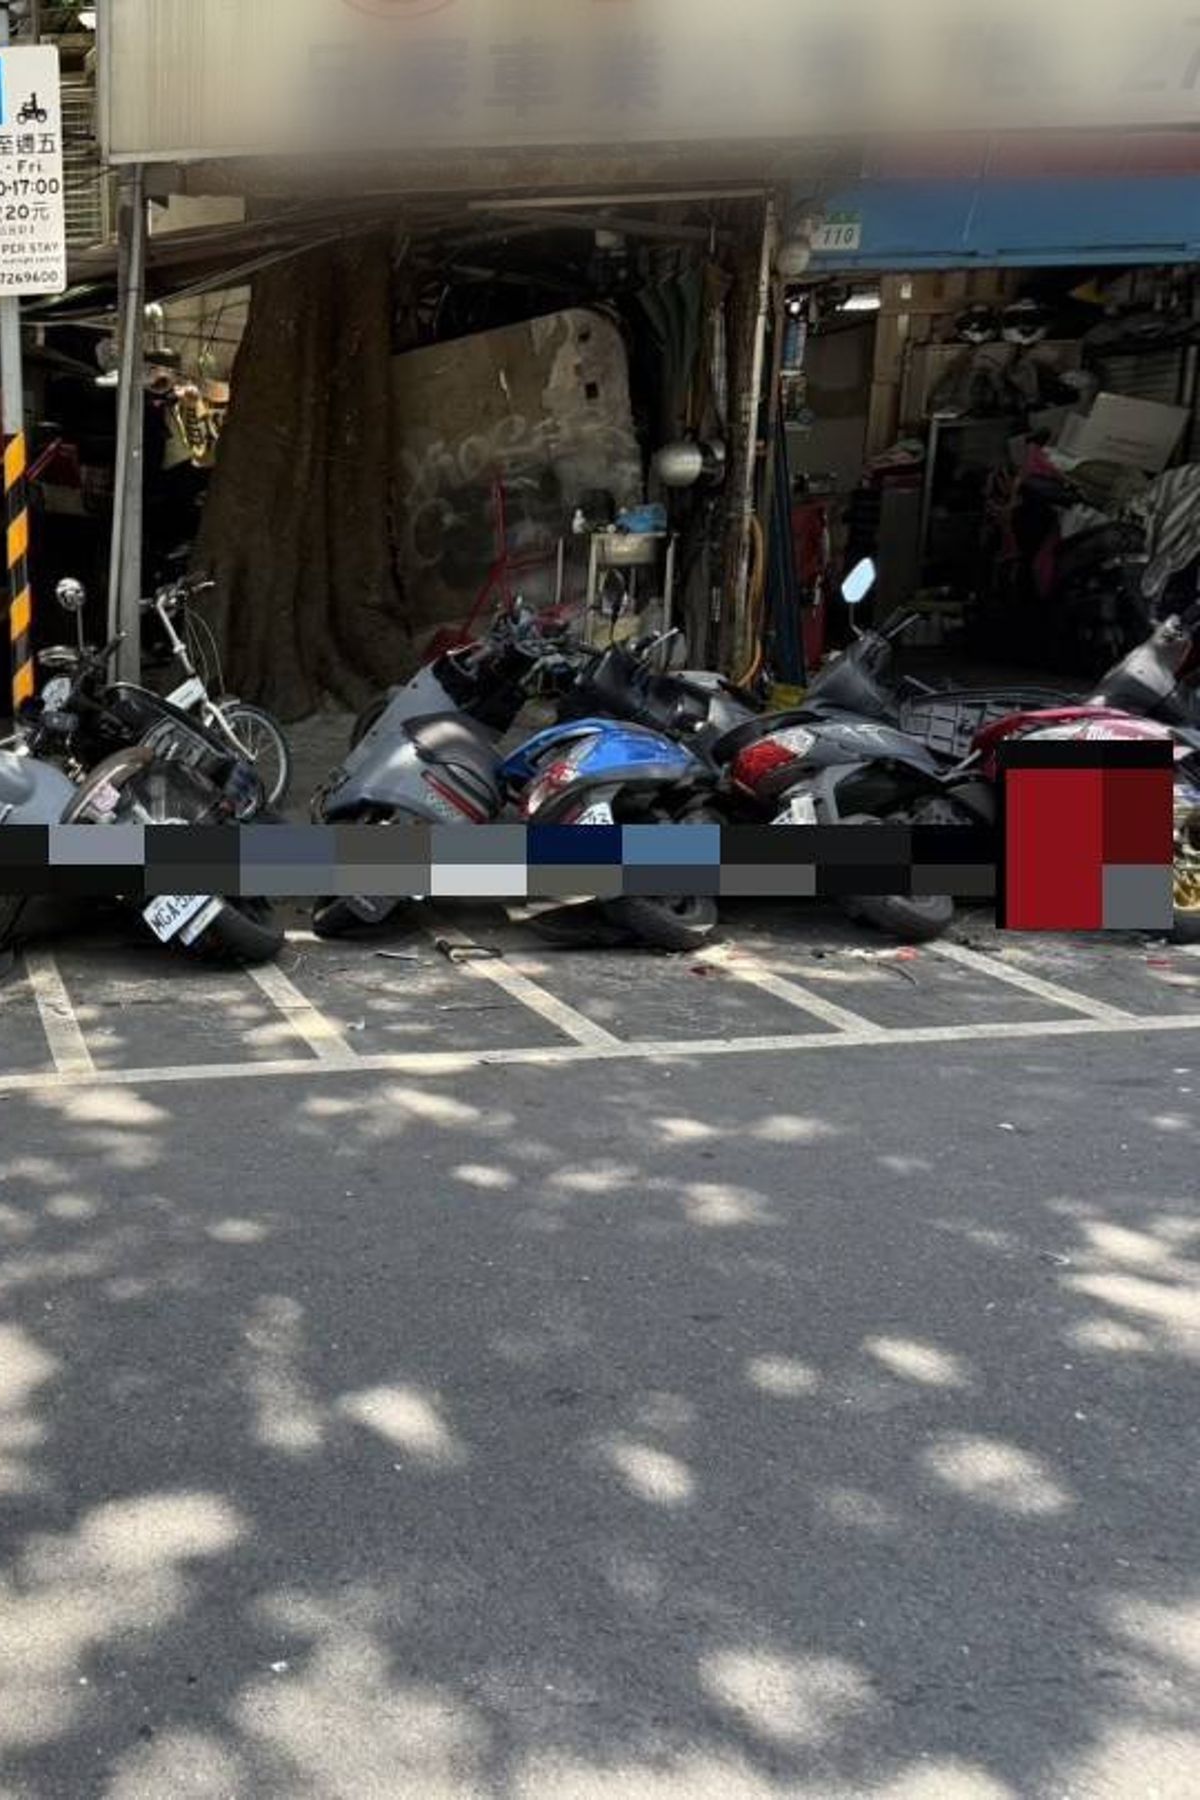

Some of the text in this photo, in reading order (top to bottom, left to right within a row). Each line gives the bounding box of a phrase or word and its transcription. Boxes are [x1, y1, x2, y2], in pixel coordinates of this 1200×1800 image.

[823, 227, 854, 246] 110
[1, 243, 26, 255] PER
[28, 241, 59, 254] STAY
